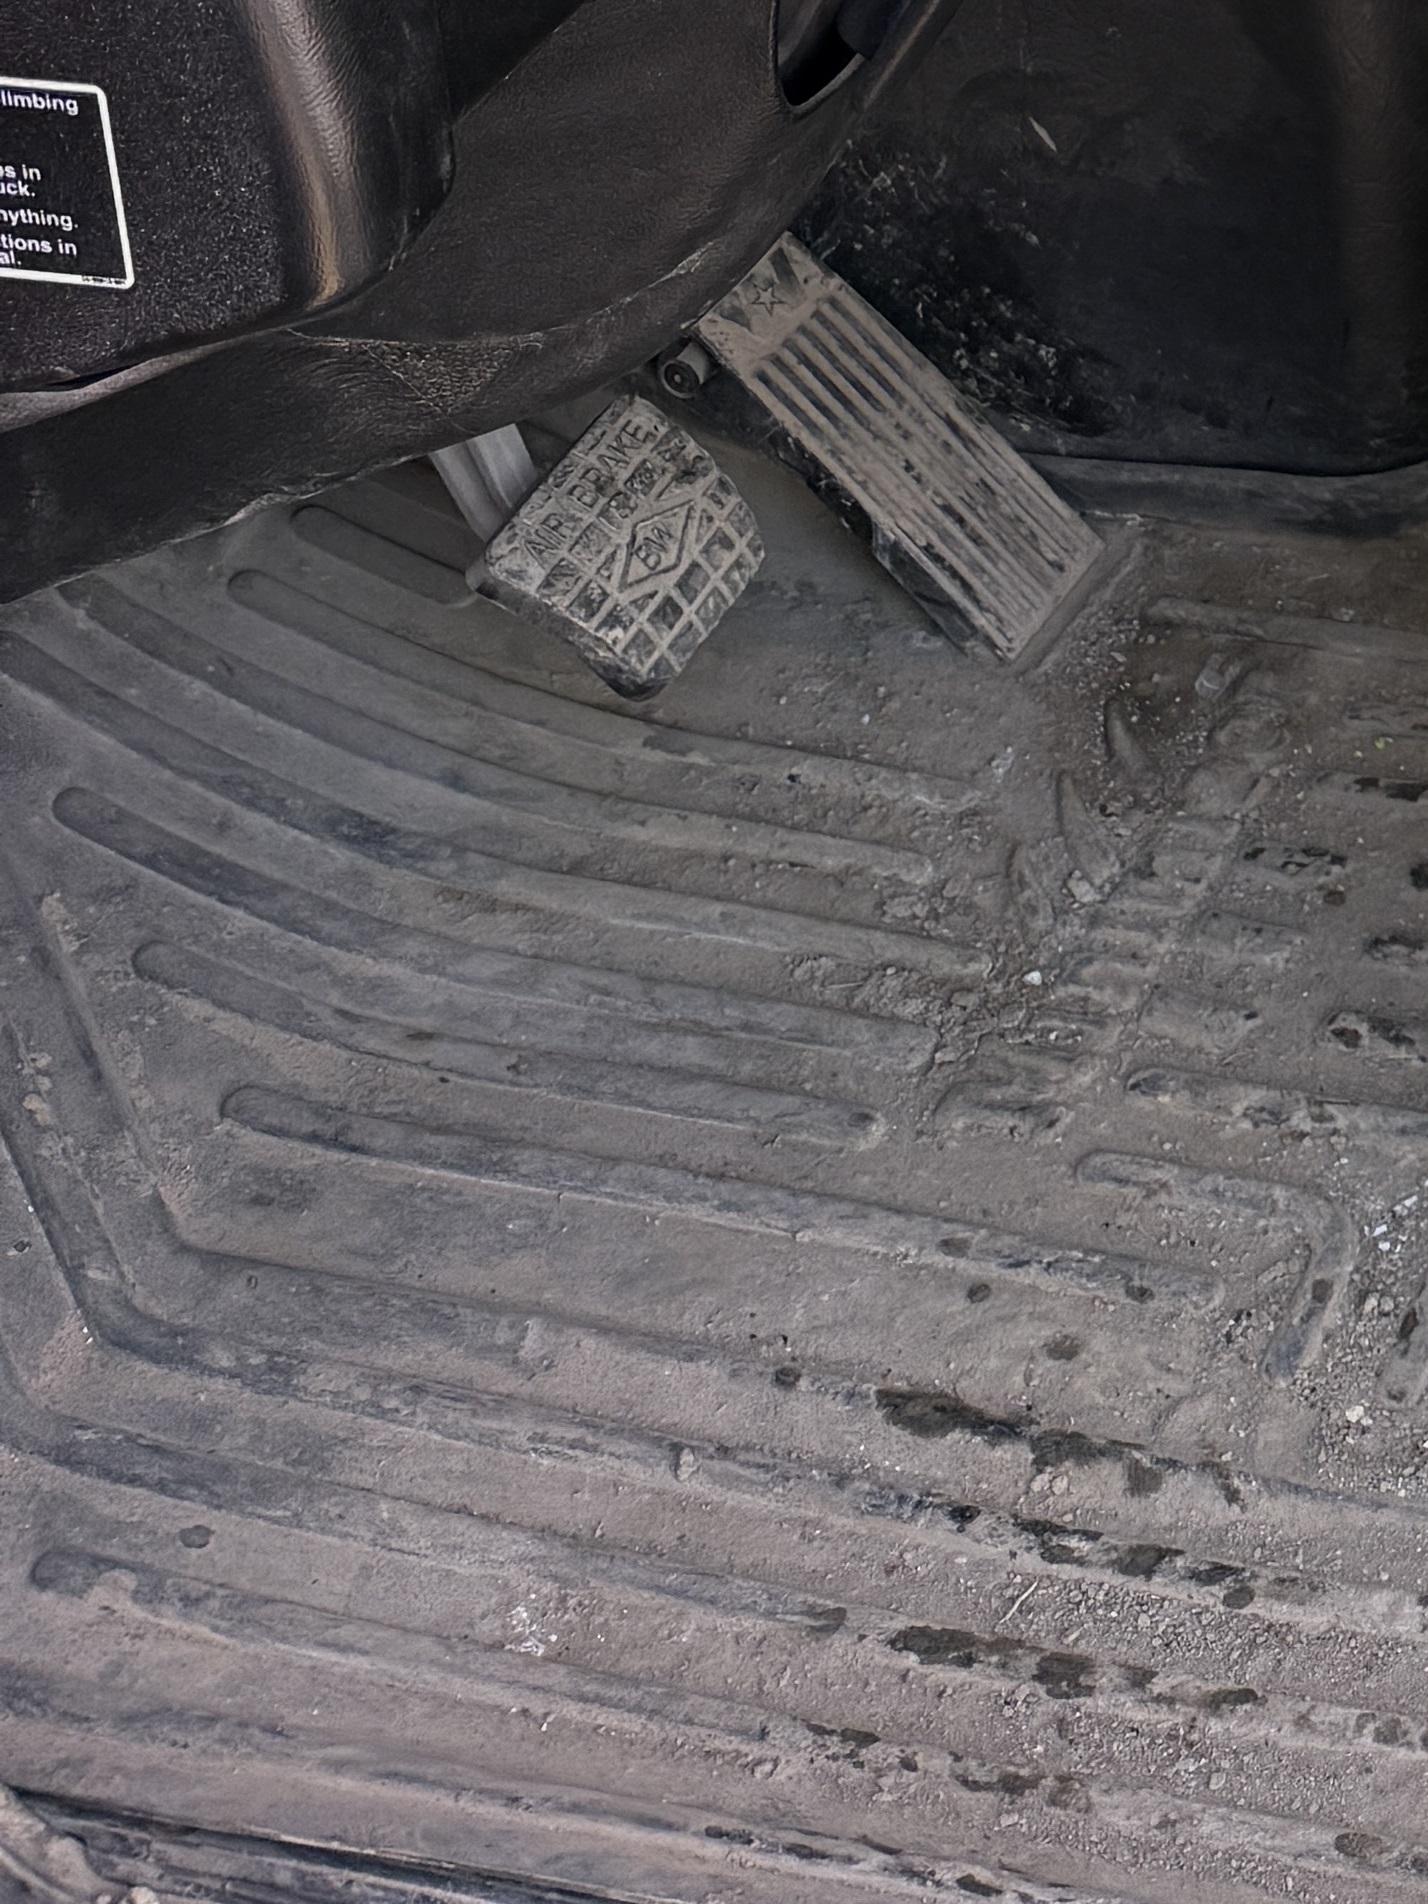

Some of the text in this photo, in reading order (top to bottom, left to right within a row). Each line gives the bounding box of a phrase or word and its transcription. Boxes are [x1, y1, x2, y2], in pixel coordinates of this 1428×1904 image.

[0, 90, 78, 116] limbing
[22, 164, 42, 182] in
[58, 238, 77, 257] in
[524, 419, 650, 570] AIR BRAKE
